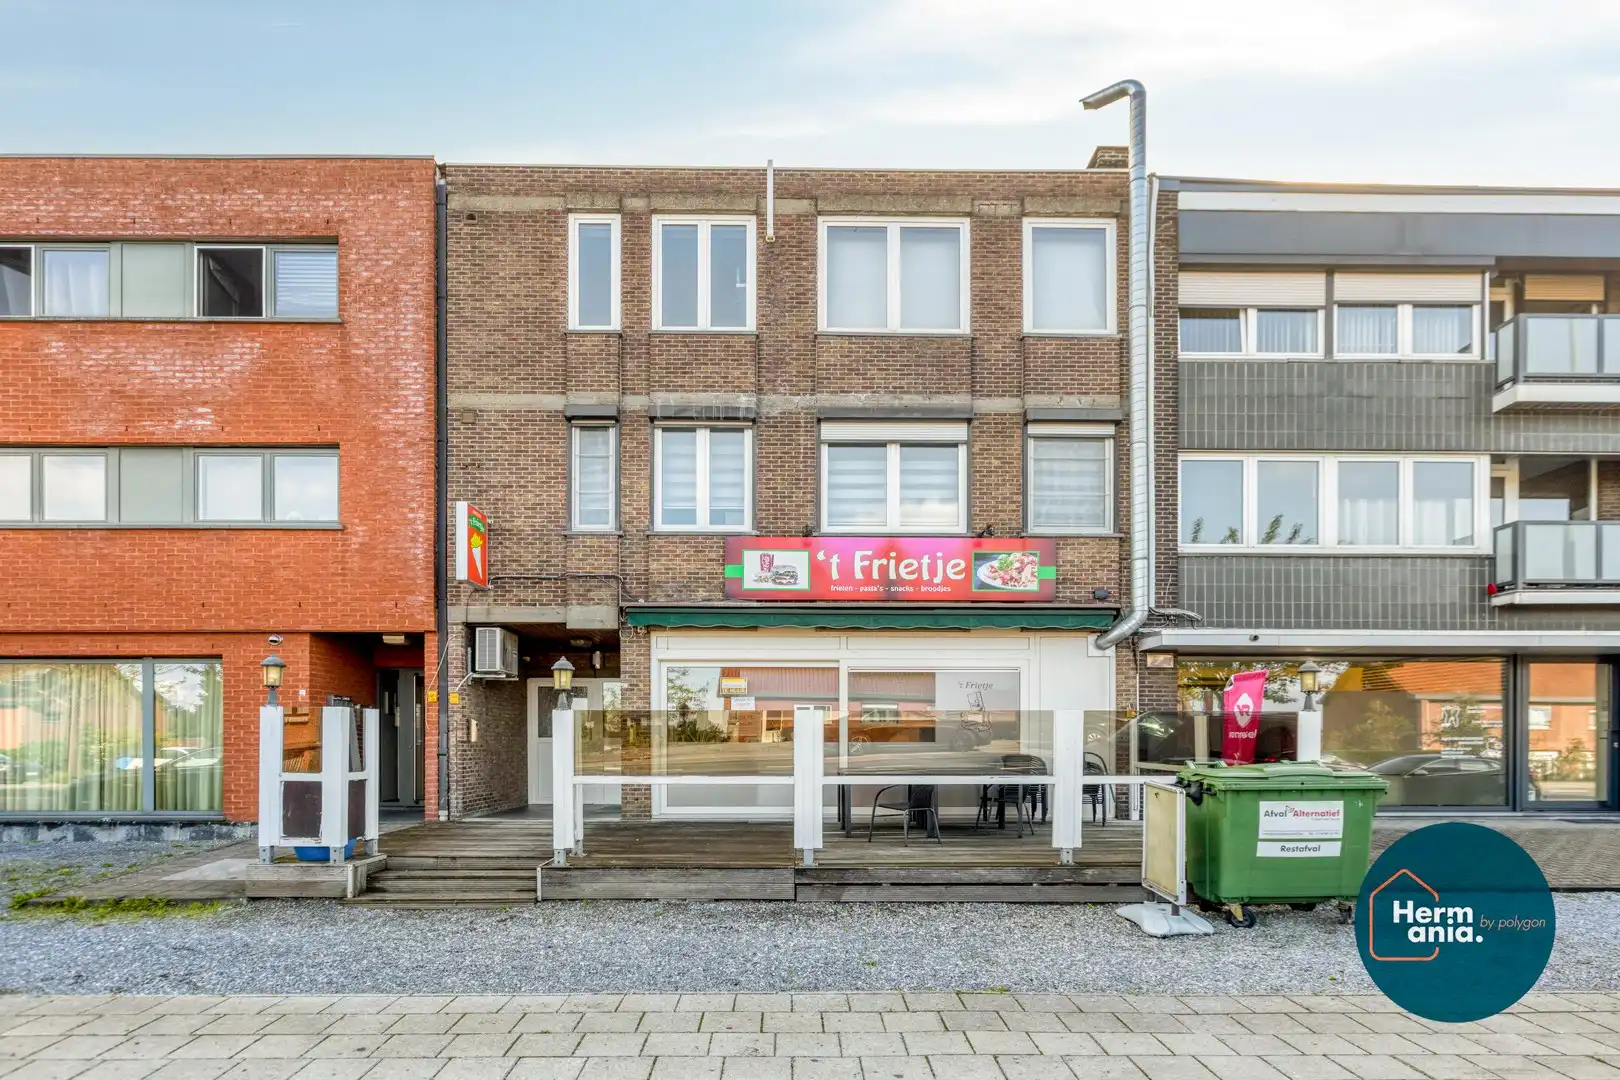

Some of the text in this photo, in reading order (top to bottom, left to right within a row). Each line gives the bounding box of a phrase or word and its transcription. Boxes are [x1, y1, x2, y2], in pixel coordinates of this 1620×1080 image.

[854, 550, 966, 583] Frietje
[830, 584, 952, 594] frieten pasta's snacks broodjes
[965, 680, 994, 691] Frietje
[1264, 809, 1340, 817] Afval Alternatief
[1280, 844, 1321, 852] Restafval
